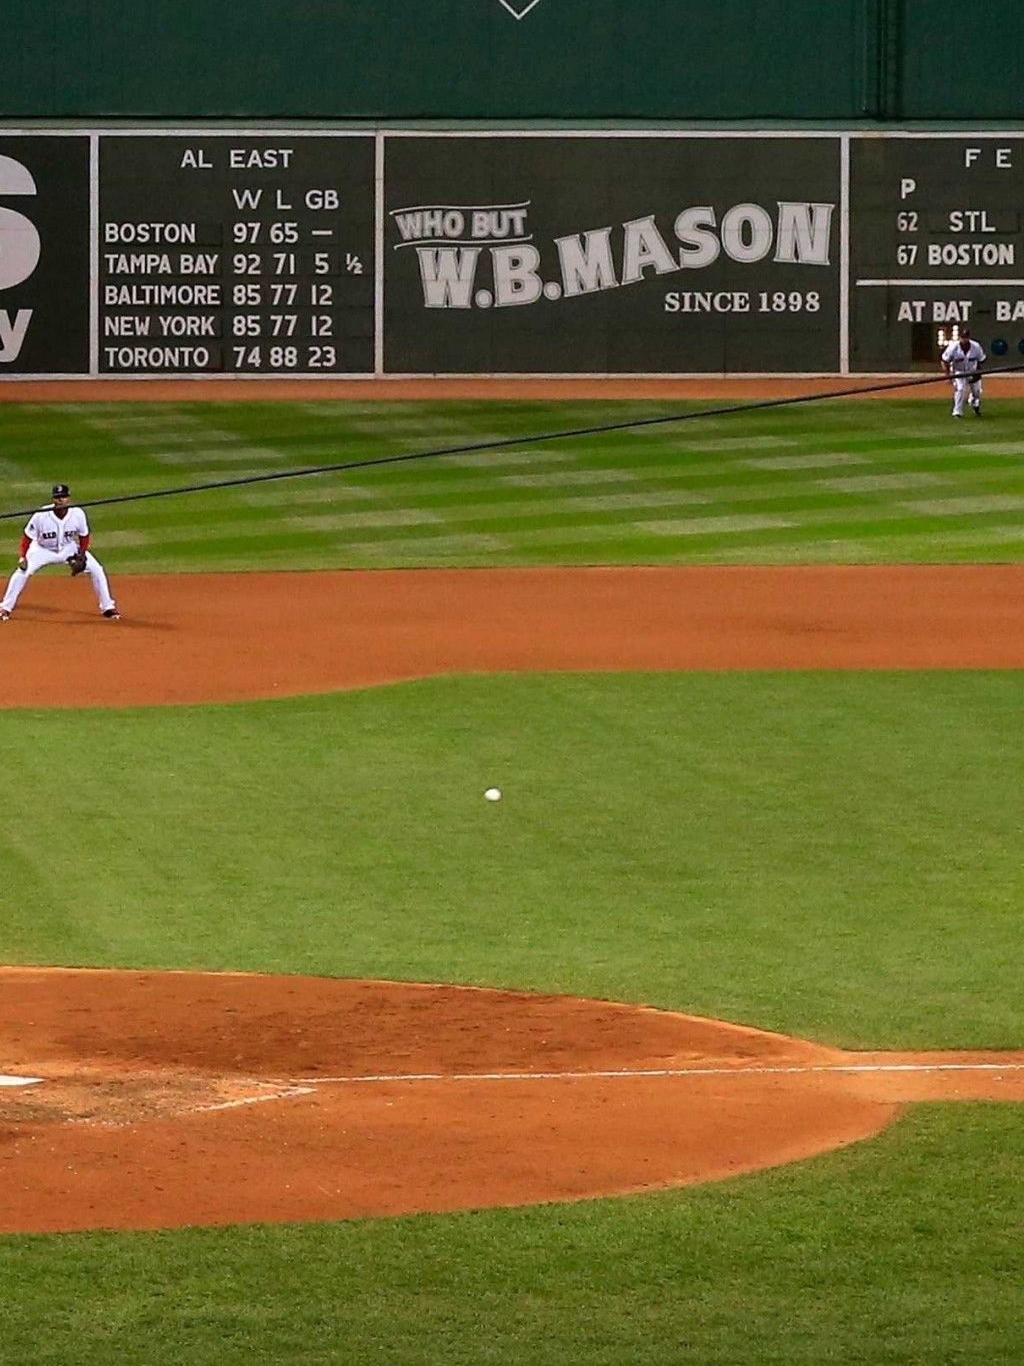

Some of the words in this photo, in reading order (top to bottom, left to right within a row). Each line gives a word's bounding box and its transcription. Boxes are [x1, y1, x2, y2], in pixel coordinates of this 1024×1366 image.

[180, 149, 213, 168] AL
[229, 149, 293, 168] EAST
[965, 148, 981, 167] F
[996, 148, 1012, 167] E
[232, 189, 262, 209] W
[277, 190, 292, 209] L
[305, 189, 339, 209] GB
[901, 178, 916, 199] P
[394, 209, 465, 240] WHO
[471, 208, 527, 238] BUT
[897, 212, 918, 231] 62
[949, 211, 996, 232] STL
[105, 223, 196, 243] BOSTON
[233, 222, 261, 243] 97
[270, 222, 299, 243] 65
[104, 254, 172, 274] TAMPA
[180, 254, 218, 274] BAY
[233, 254, 261, 274] 92
[273, 254, 295, 274] 71
[314, 254, 329, 274] 5
[897, 245, 917, 265] 67
[928, 244, 1014, 266] BOSTON
[104, 285, 220, 305] BALTIMORE
[233, 285, 261, 305] 85
[270, 285, 298, 305] 77
[311, 285, 333, 305] 12
[664, 291, 750, 312] SINCE
[758, 291, 821, 312] 1898
[897, 301, 926, 322] AT
[932, 301, 972, 322] BAT
[105, 316, 150, 336] NEW
[160, 316, 215, 336] YORK
[233, 315, 261, 336] 85
[270, 315, 298, 336] 77
[311, 315, 333, 336] 12
[104, 347, 209, 367] TORONTO
[233, 347, 262, 367] 74
[270, 347, 298, 367] 88
[308, 347, 336, 367] 23
